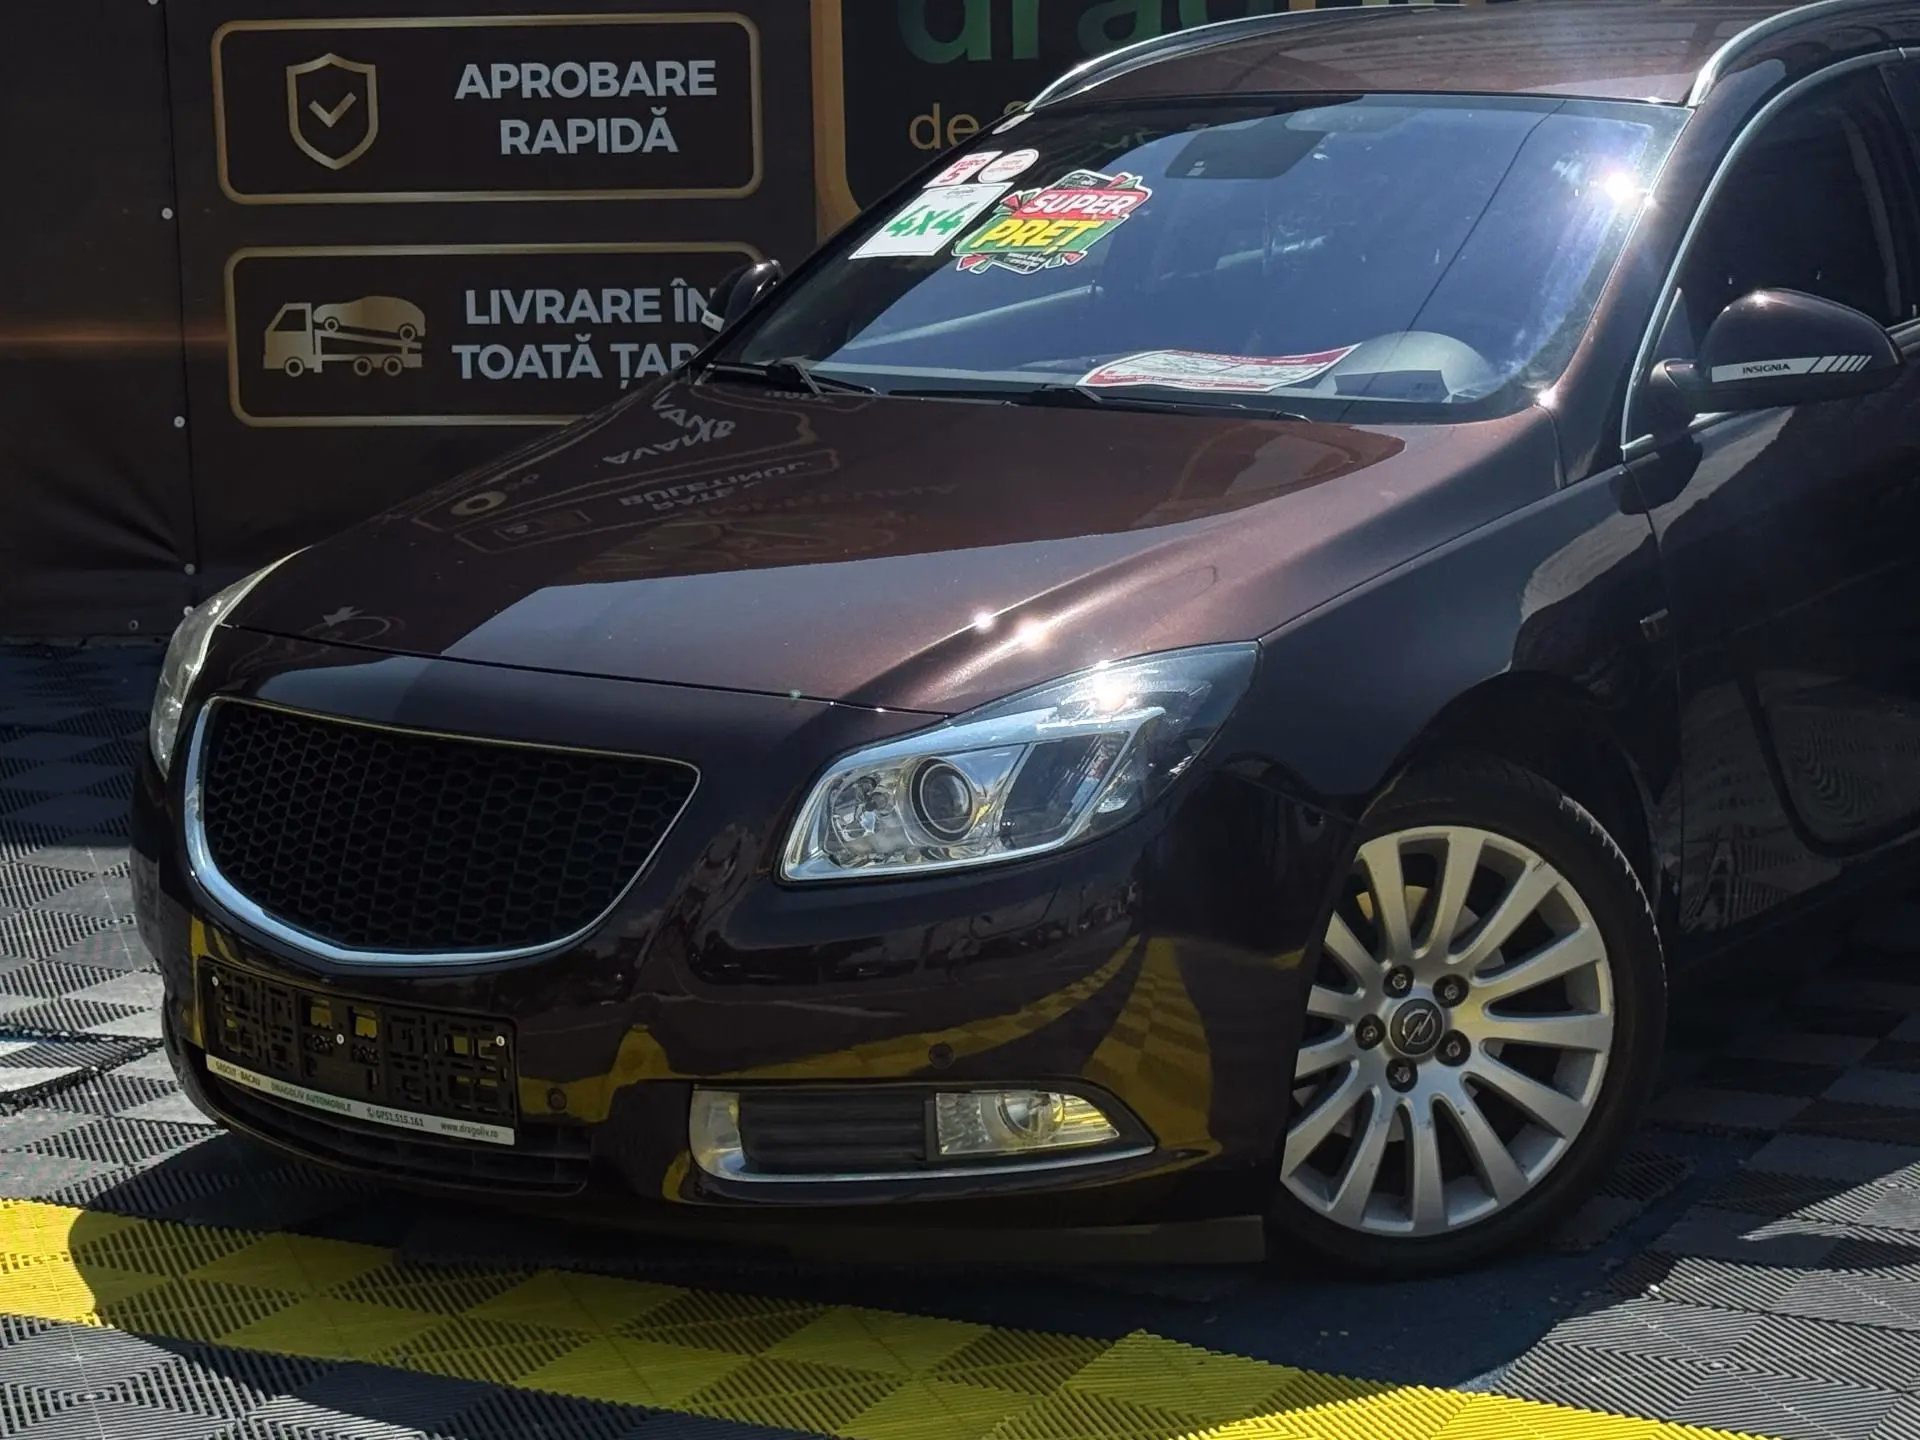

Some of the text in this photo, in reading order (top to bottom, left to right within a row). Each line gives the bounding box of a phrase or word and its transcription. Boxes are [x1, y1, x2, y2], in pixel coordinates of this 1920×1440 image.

[455, 60, 718, 101] APROBARE
[500, 106, 679, 155] RAPIDĂ
[909, 103, 980, 150] de
[1021, 193, 1138, 215] SUPER
[465, 286, 661, 326] LIVRARE
[452, 334, 602, 381] TOATĂ
[1742, 362, 1791, 375] INSIGNIA
